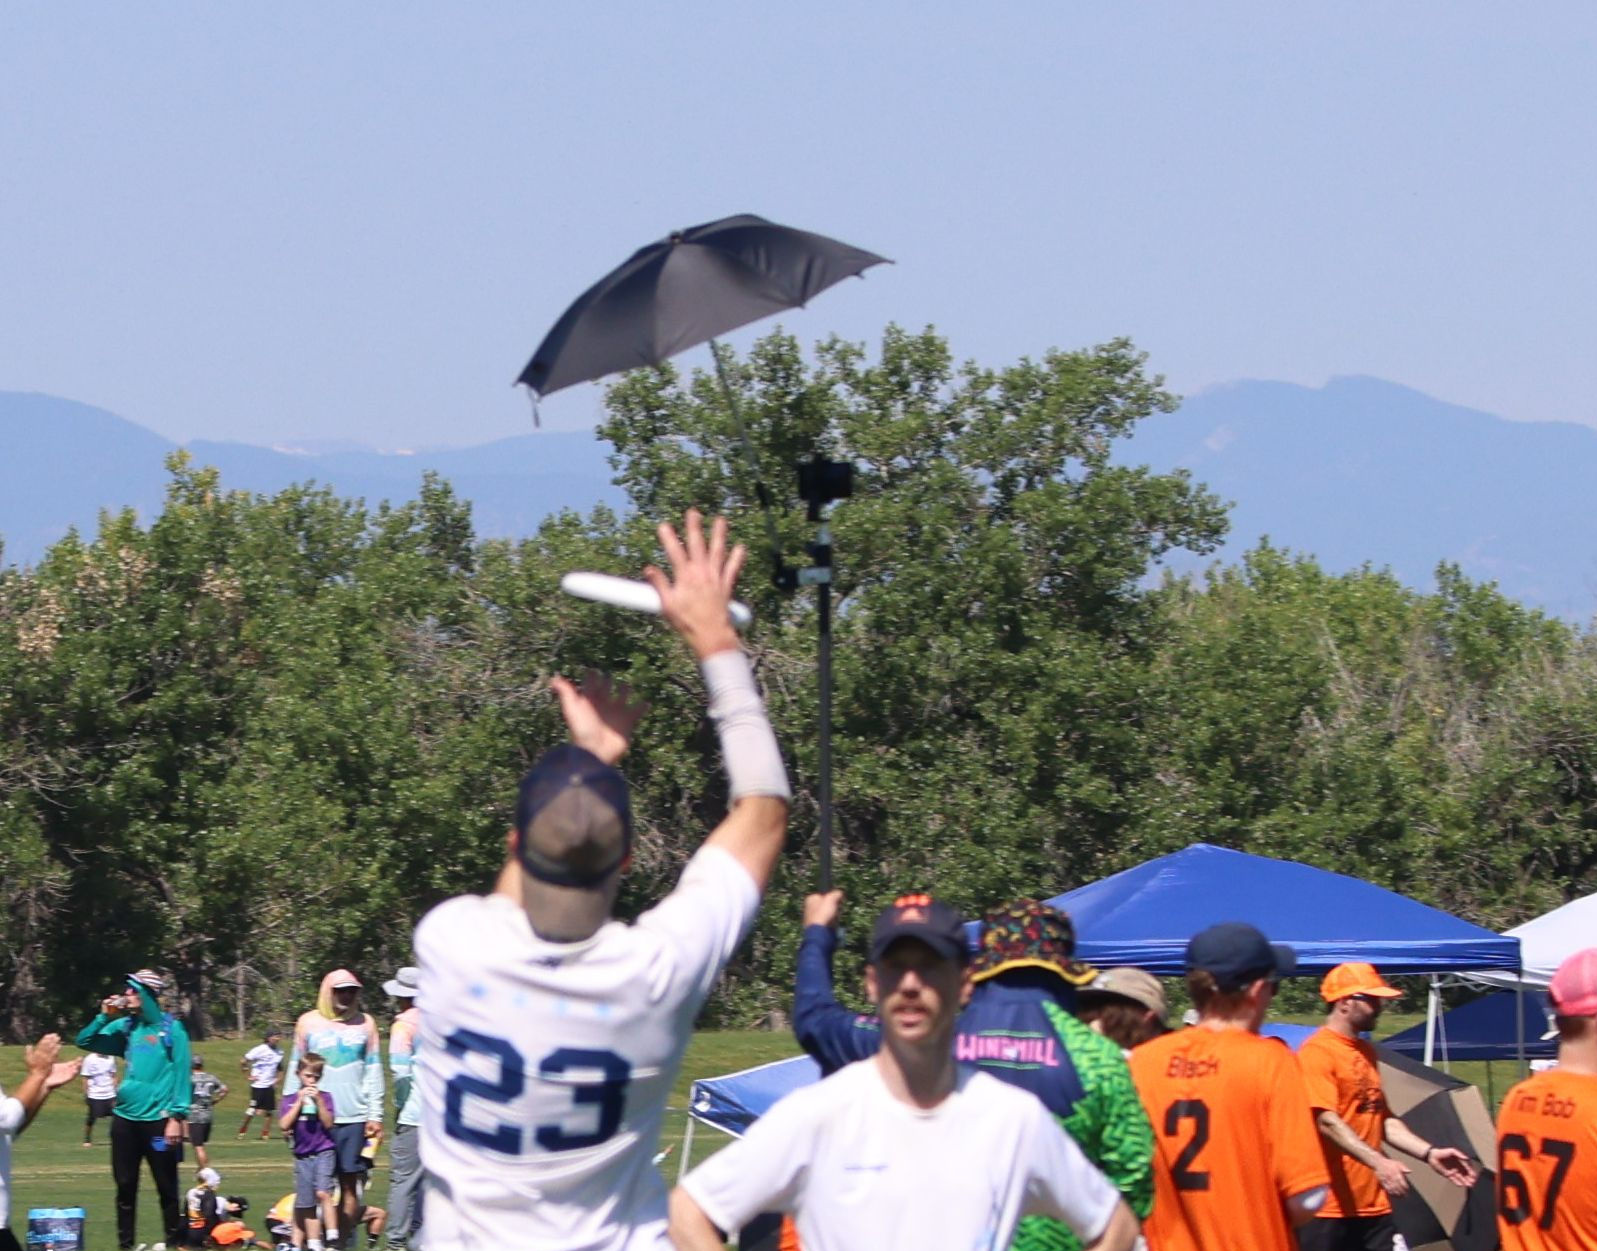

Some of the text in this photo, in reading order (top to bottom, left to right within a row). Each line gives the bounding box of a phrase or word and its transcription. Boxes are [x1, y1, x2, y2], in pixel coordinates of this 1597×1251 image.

[444, 1026, 631, 1154] 23
[1164, 1099, 1210, 1191] 2
[1498, 1132, 1576, 1231] 67
